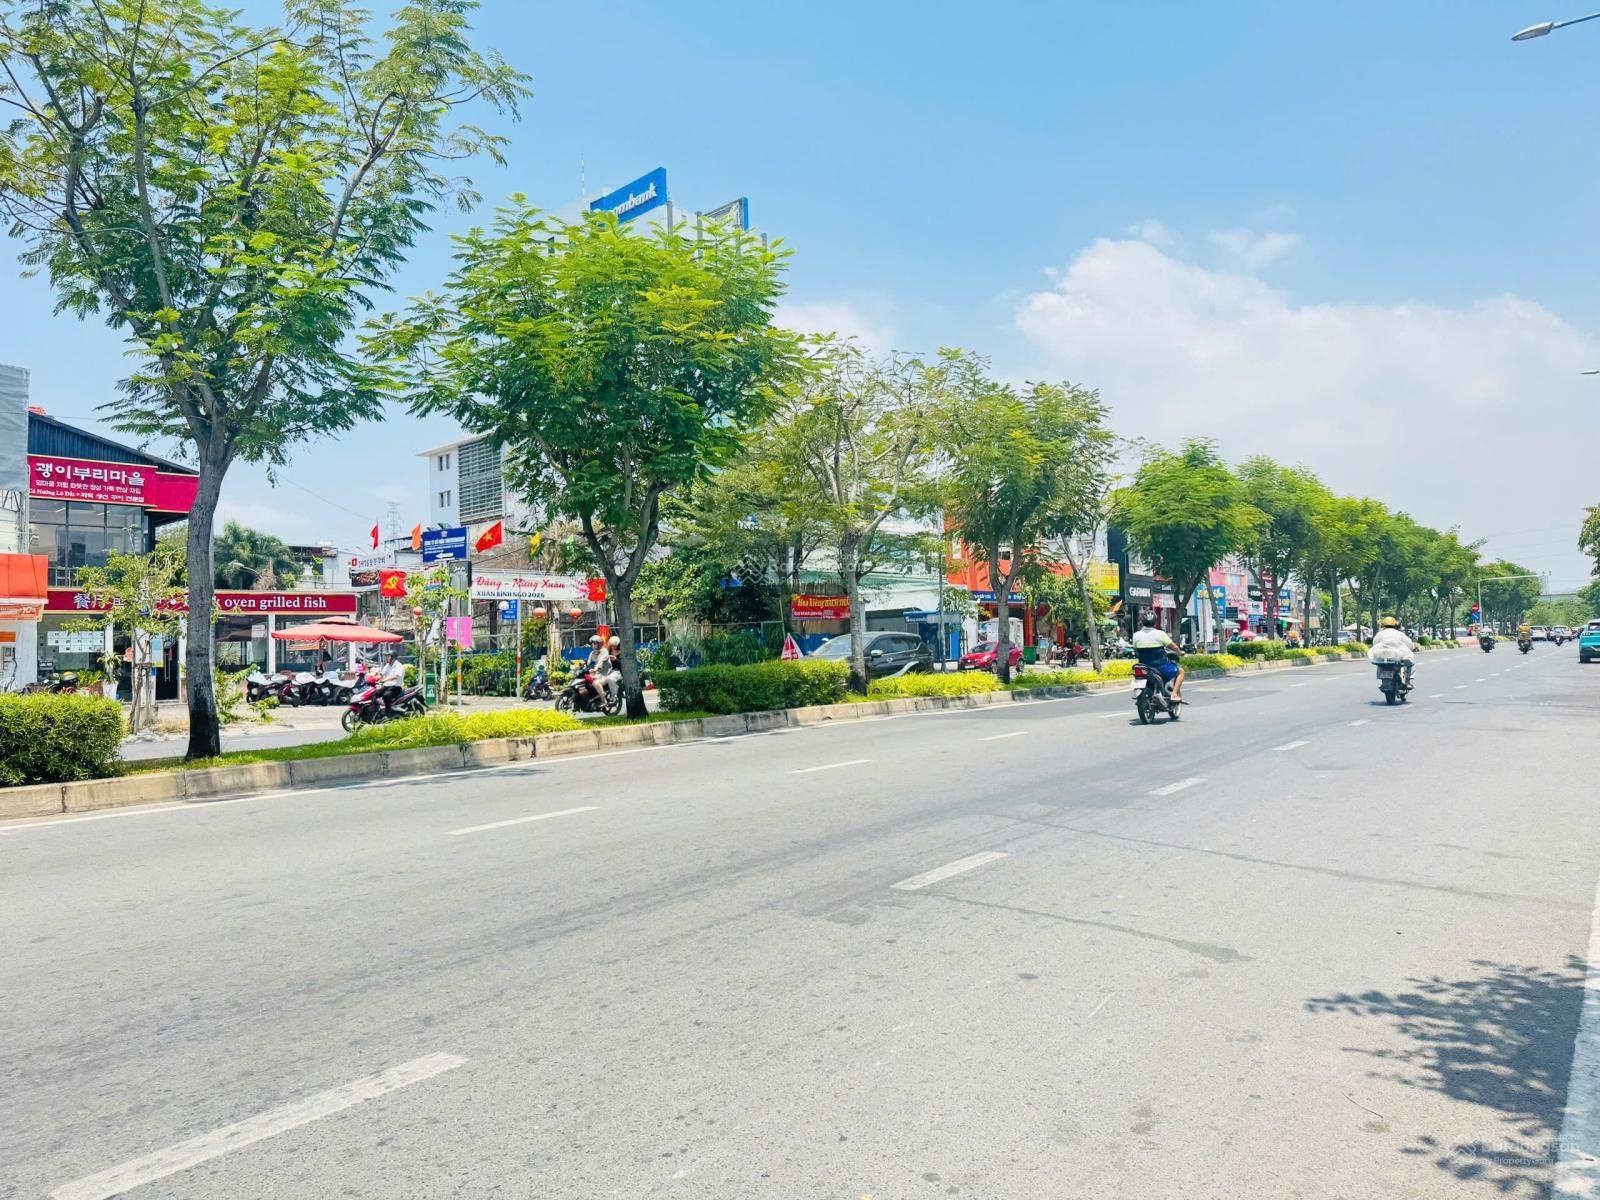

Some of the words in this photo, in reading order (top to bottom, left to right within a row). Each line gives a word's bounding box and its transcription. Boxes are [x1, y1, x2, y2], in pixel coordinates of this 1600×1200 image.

[35, 463, 144, 486] 괭이부리마을
[1129, 587, 1151, 597] GARMIN
[260, 597, 301, 610] grilled
[303, 597, 327, 608] fish
